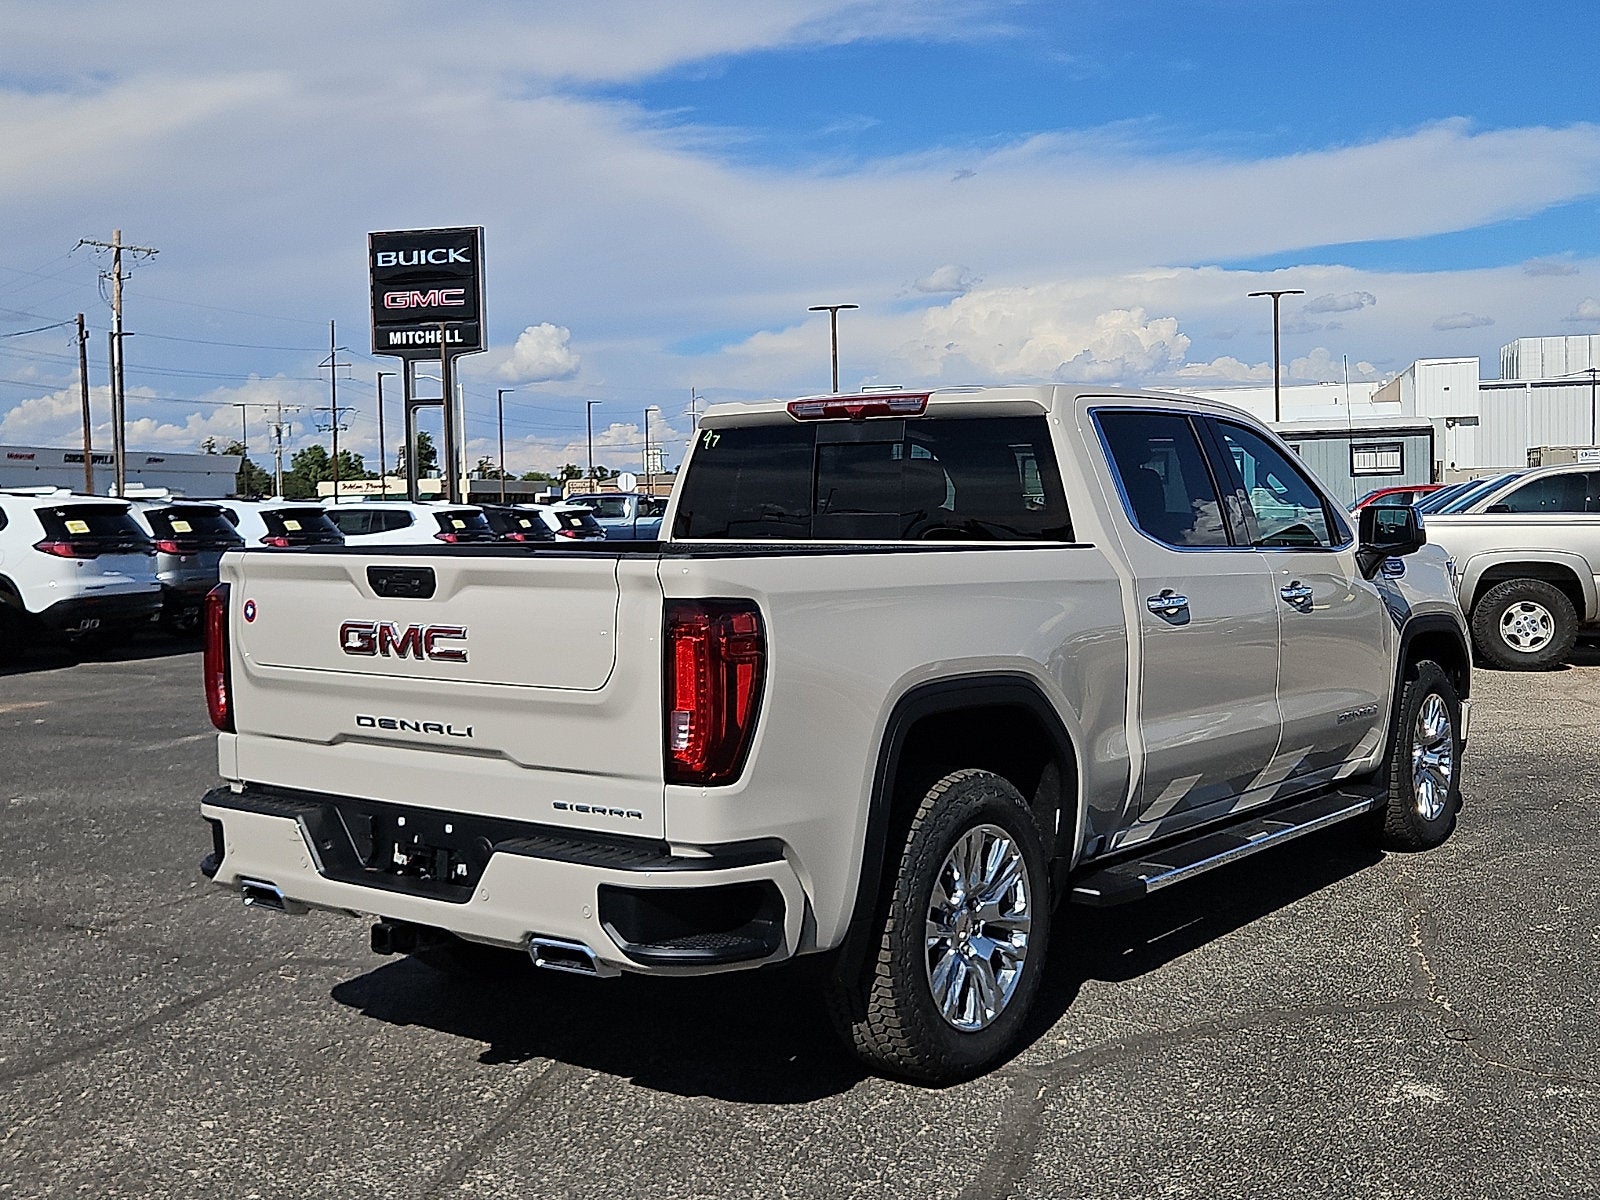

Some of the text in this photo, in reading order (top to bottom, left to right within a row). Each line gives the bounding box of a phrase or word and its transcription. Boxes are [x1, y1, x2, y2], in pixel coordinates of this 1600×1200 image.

[376, 247, 471, 266] BUICK
[384, 288, 465, 309] GMC
[389, 329, 463, 345] MITCHELL
[339, 619, 469, 663] GMC
[355, 714, 474, 738] DENALI
[552, 801, 643, 820] SIERRA
